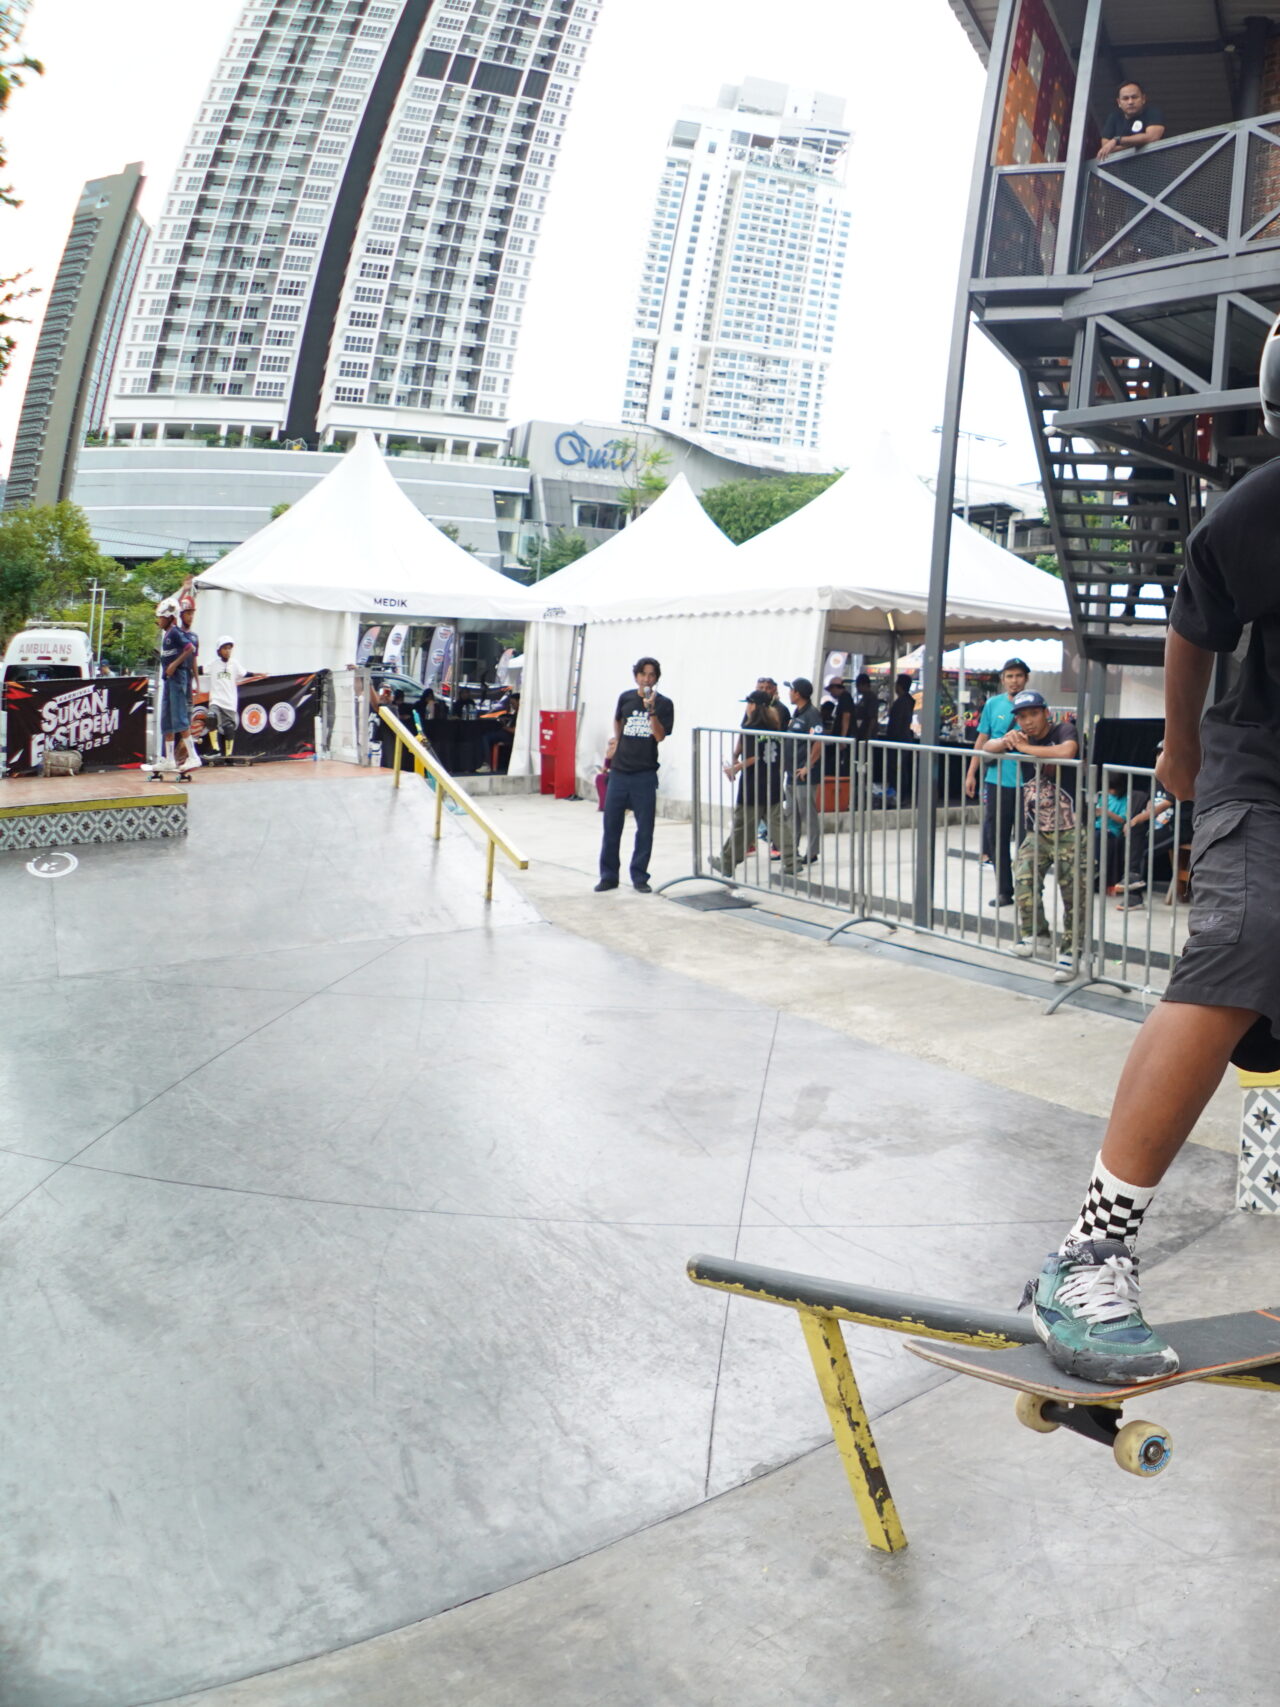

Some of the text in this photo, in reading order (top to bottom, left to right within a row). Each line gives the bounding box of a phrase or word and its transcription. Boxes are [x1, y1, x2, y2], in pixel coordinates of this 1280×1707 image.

[373, 597, 408, 608] MEDIK
[18, 643, 73, 655] AMBULANS
[41, 687, 109, 732] SUKAN
[30, 707, 120, 767] EKSTREM
[77, 735, 111, 752] 2025
